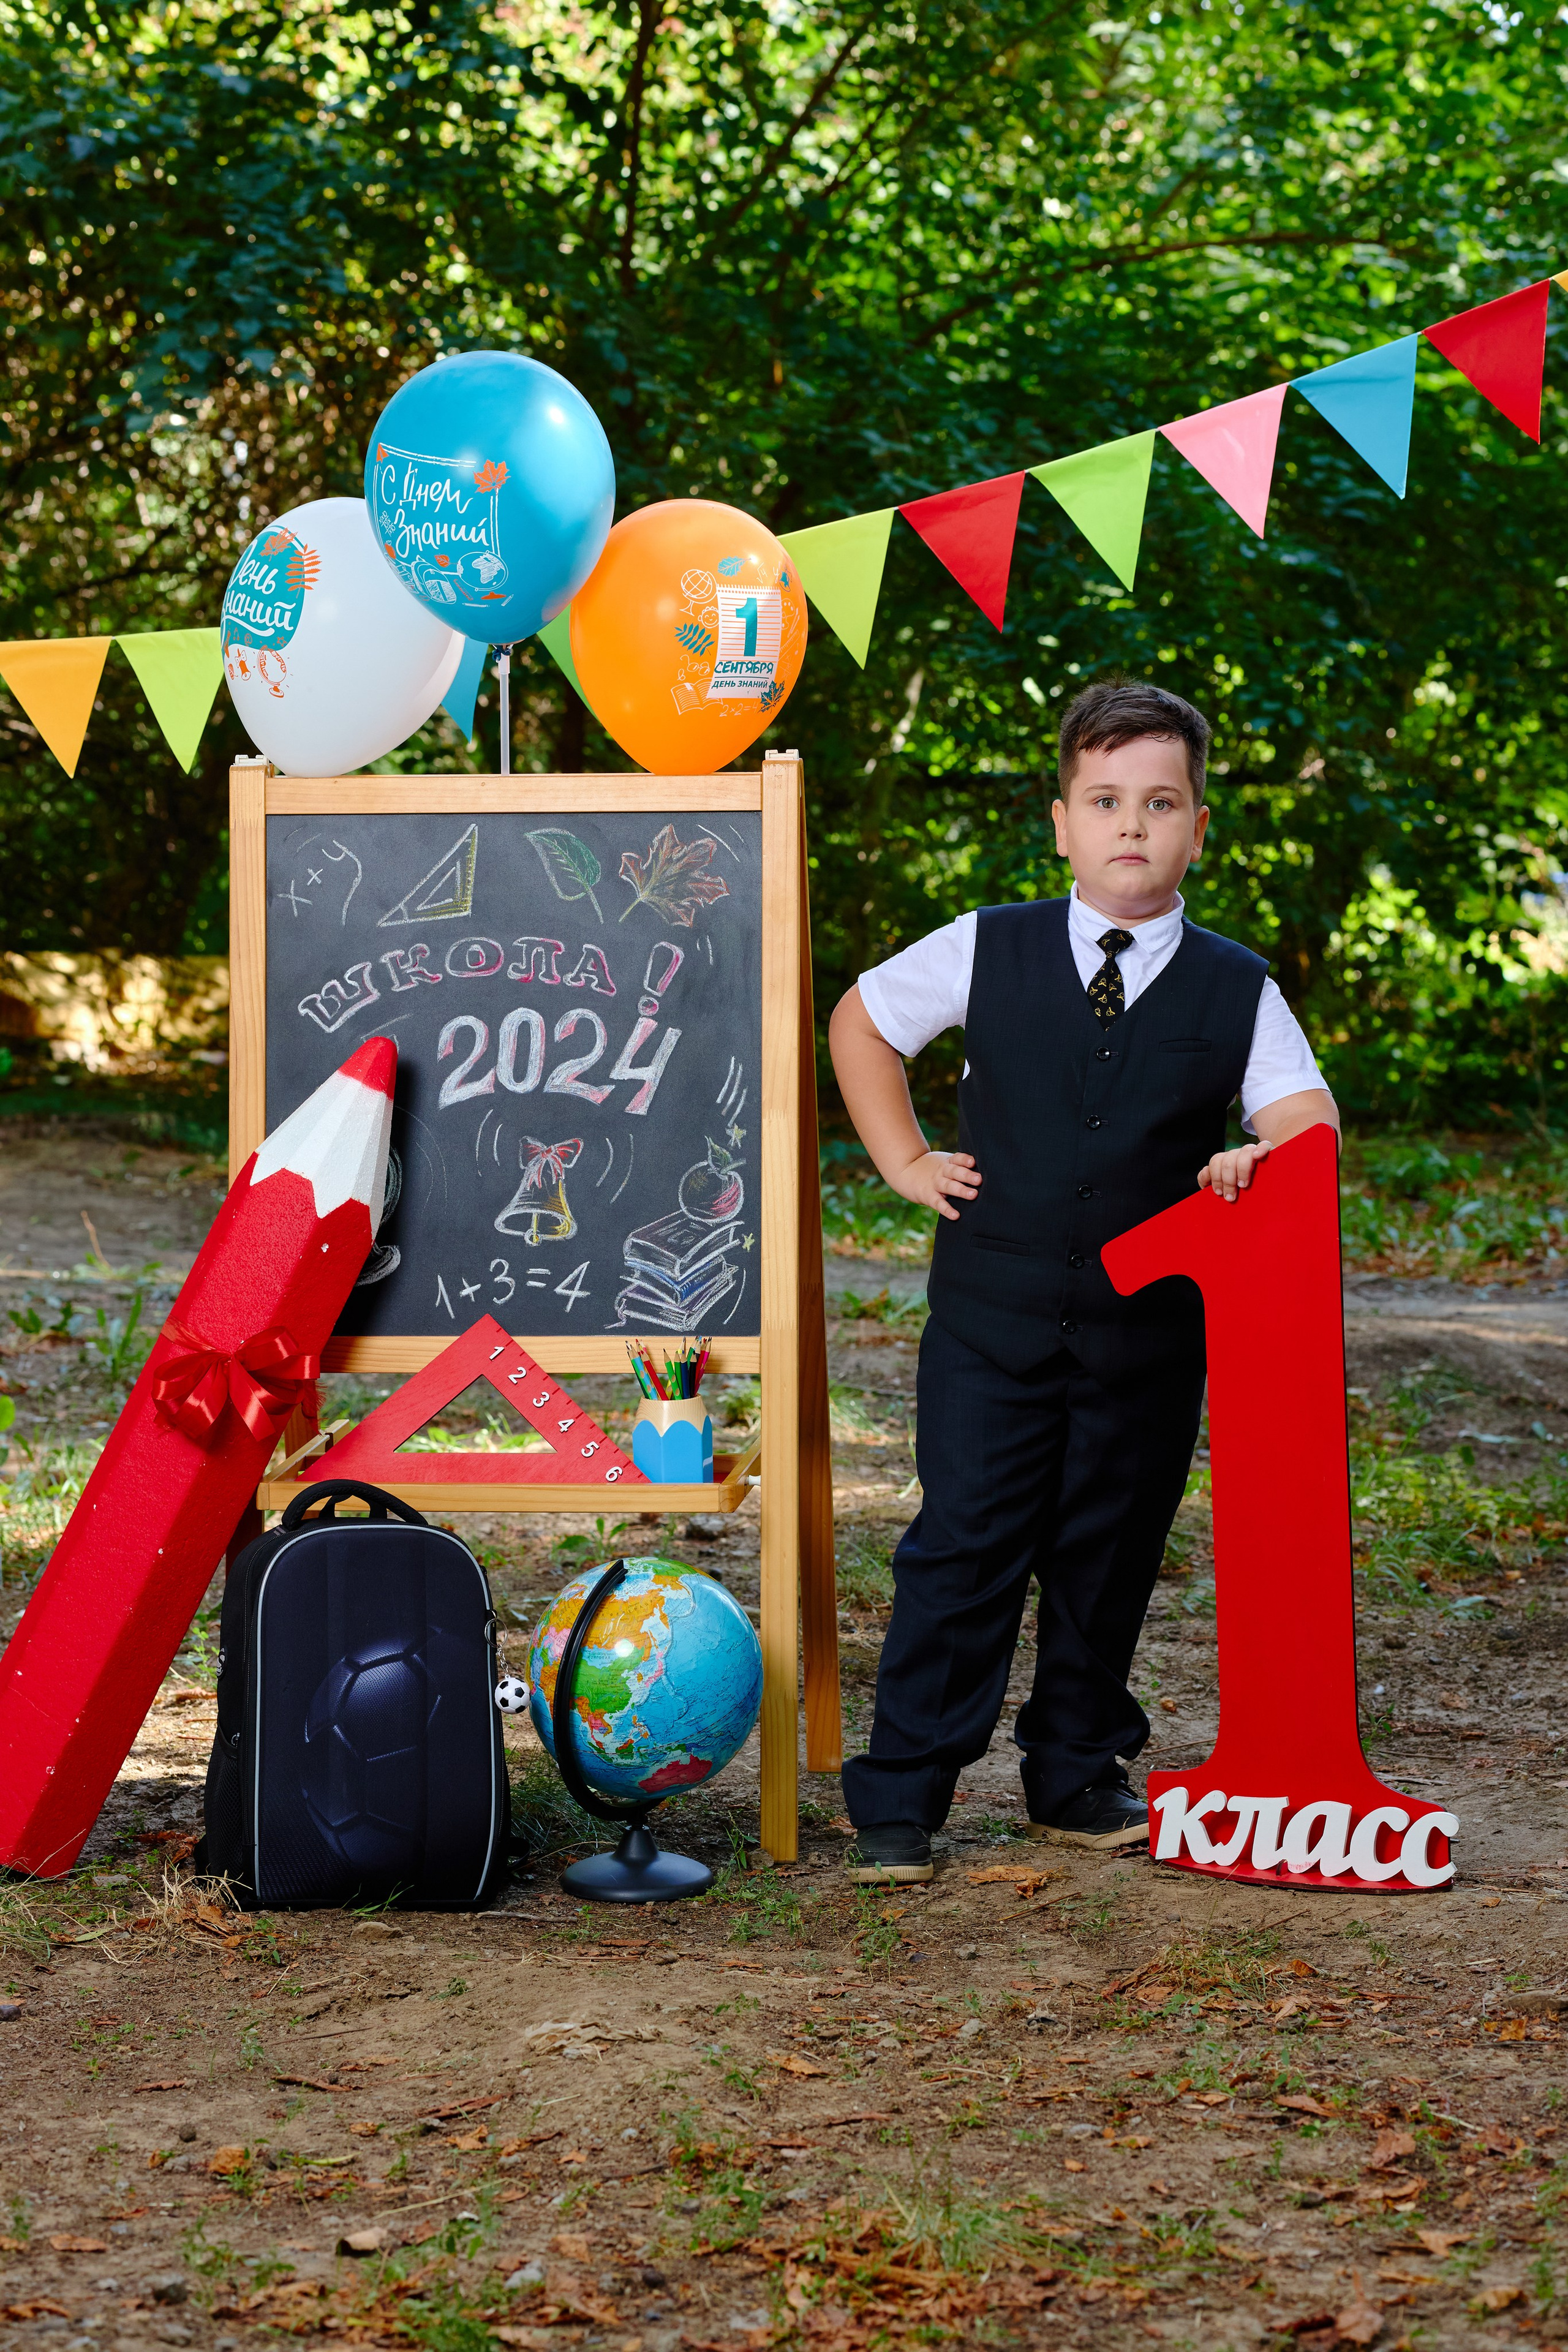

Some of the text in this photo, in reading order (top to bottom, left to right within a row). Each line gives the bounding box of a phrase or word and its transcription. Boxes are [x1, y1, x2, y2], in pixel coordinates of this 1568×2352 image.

[399, 461, 474, 514] Днем
[393, 508, 489, 559] Знаний
[221, 589, 297, 638] наний
[735, 597, 758, 657] 1
[711, 680, 769, 689] ДЕНЬ ЗНАНИЙ
[714, 660, 774, 675] СЕНТЯБРЯ
[437, 1007, 682, 1117] 2024
[489, 1346, 624, 1482] 1 2 3 4 5 6
[1152, 1786, 1461, 1887] класс
